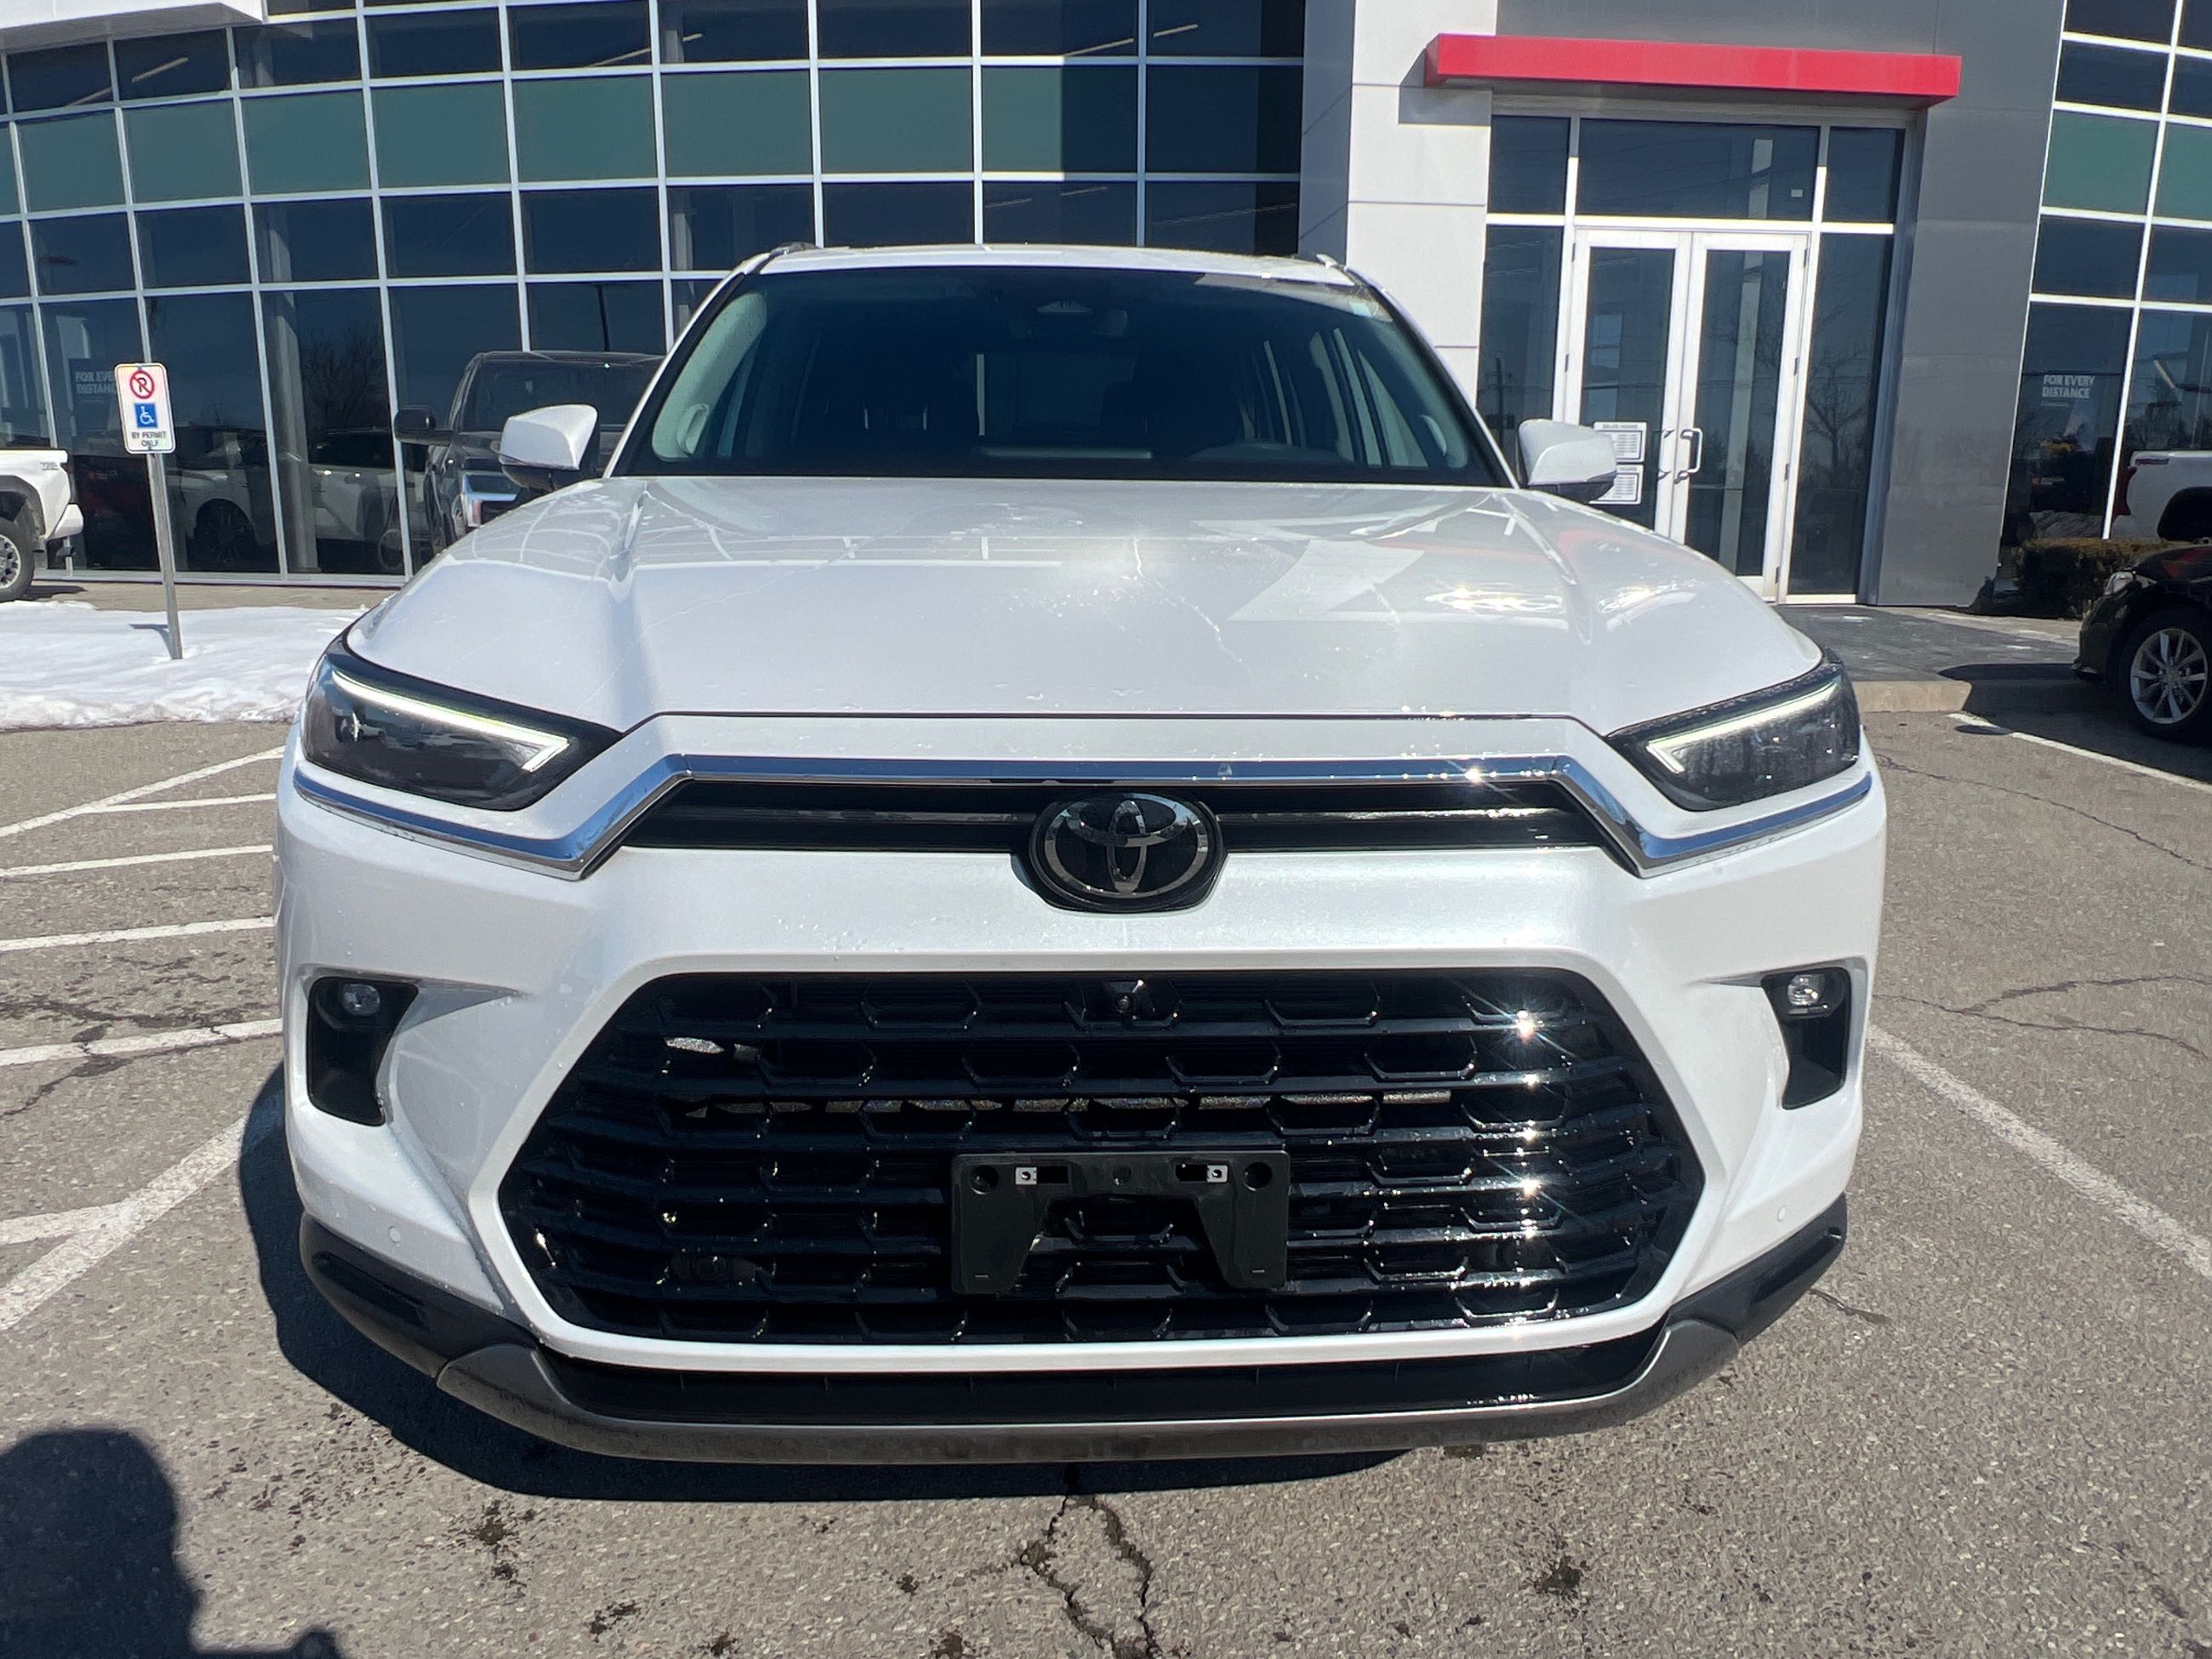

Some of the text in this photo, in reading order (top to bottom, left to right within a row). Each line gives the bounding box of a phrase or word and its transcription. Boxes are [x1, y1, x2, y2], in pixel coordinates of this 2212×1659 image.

[2043, 374, 2095, 386] FOR EVERY
[2042, 386, 2090, 399] DISTANCE
[142, 430, 167, 439] PERMIT
